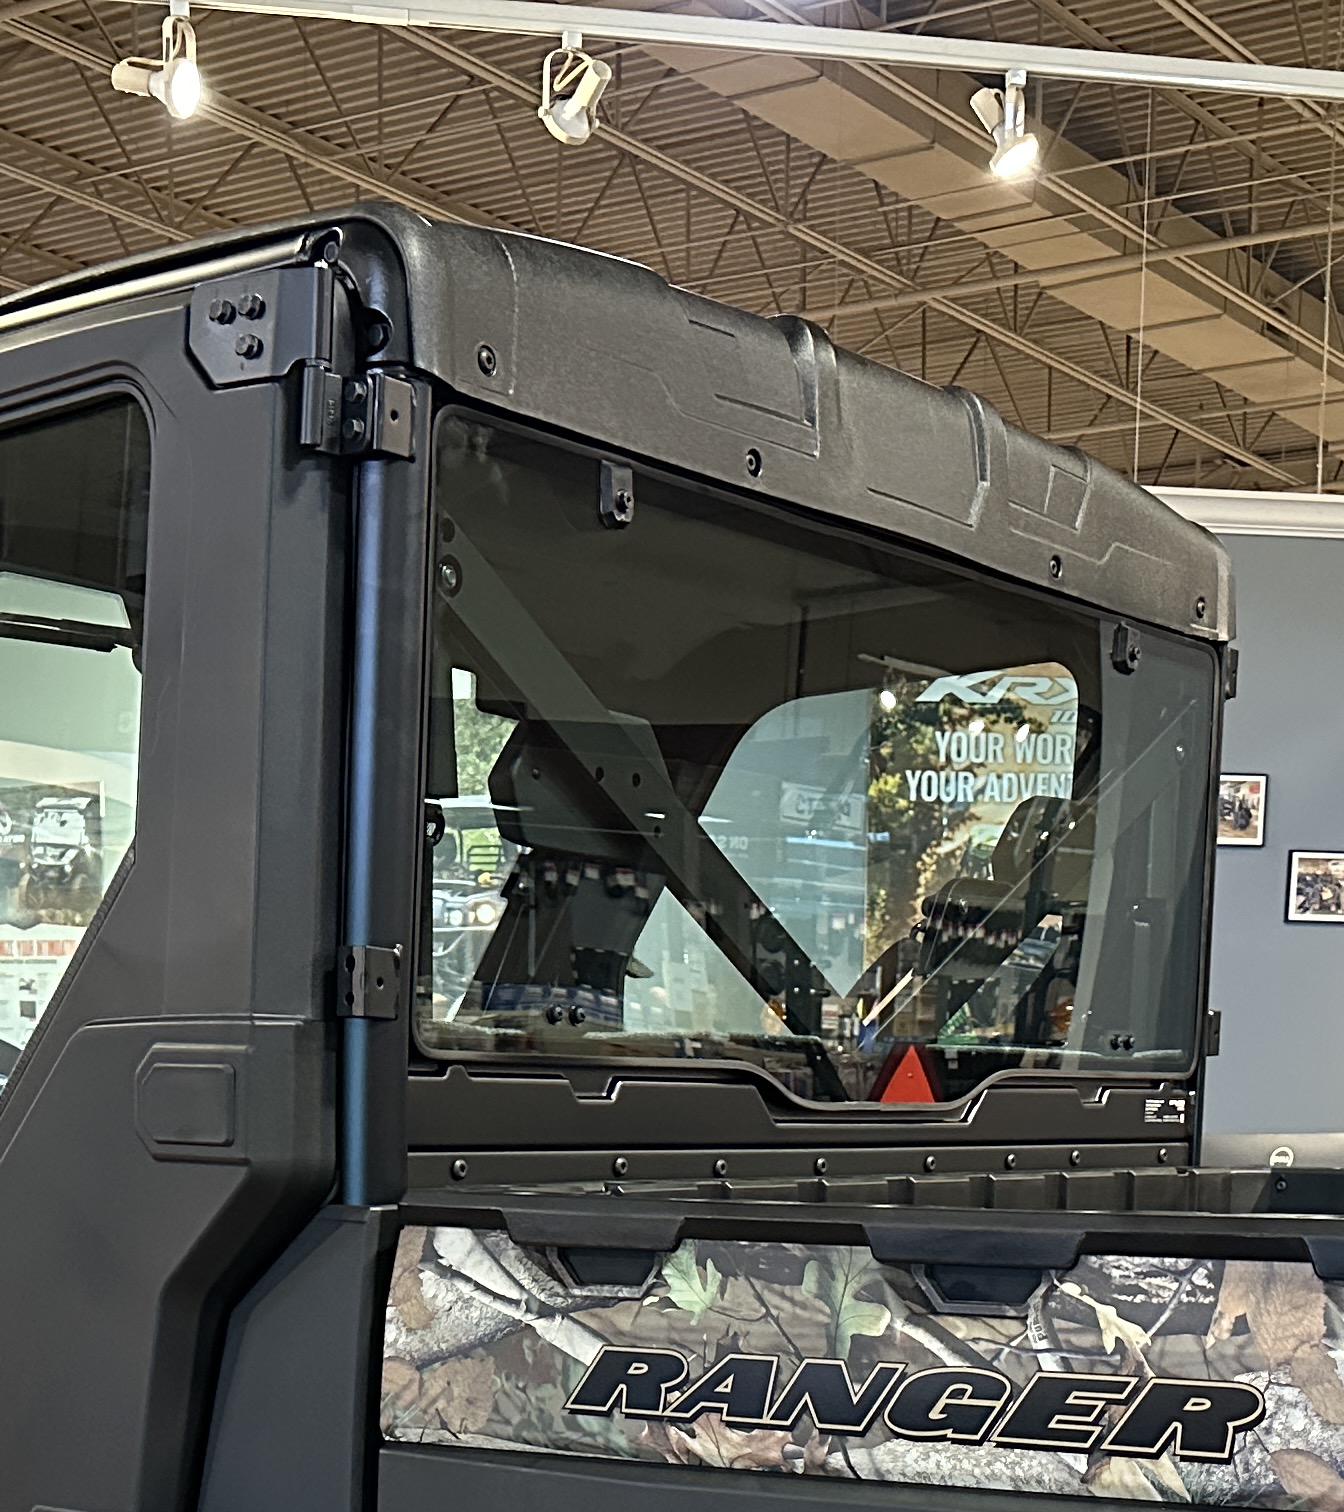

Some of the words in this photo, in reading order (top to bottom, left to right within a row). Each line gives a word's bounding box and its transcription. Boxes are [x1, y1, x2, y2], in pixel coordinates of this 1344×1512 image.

[935, 731, 1004, 764] YOUR
[1015, 732, 1073, 764] WOR
[905, 770, 974, 803] YOUR
[564, 1344, 1266, 1463] RANGER
